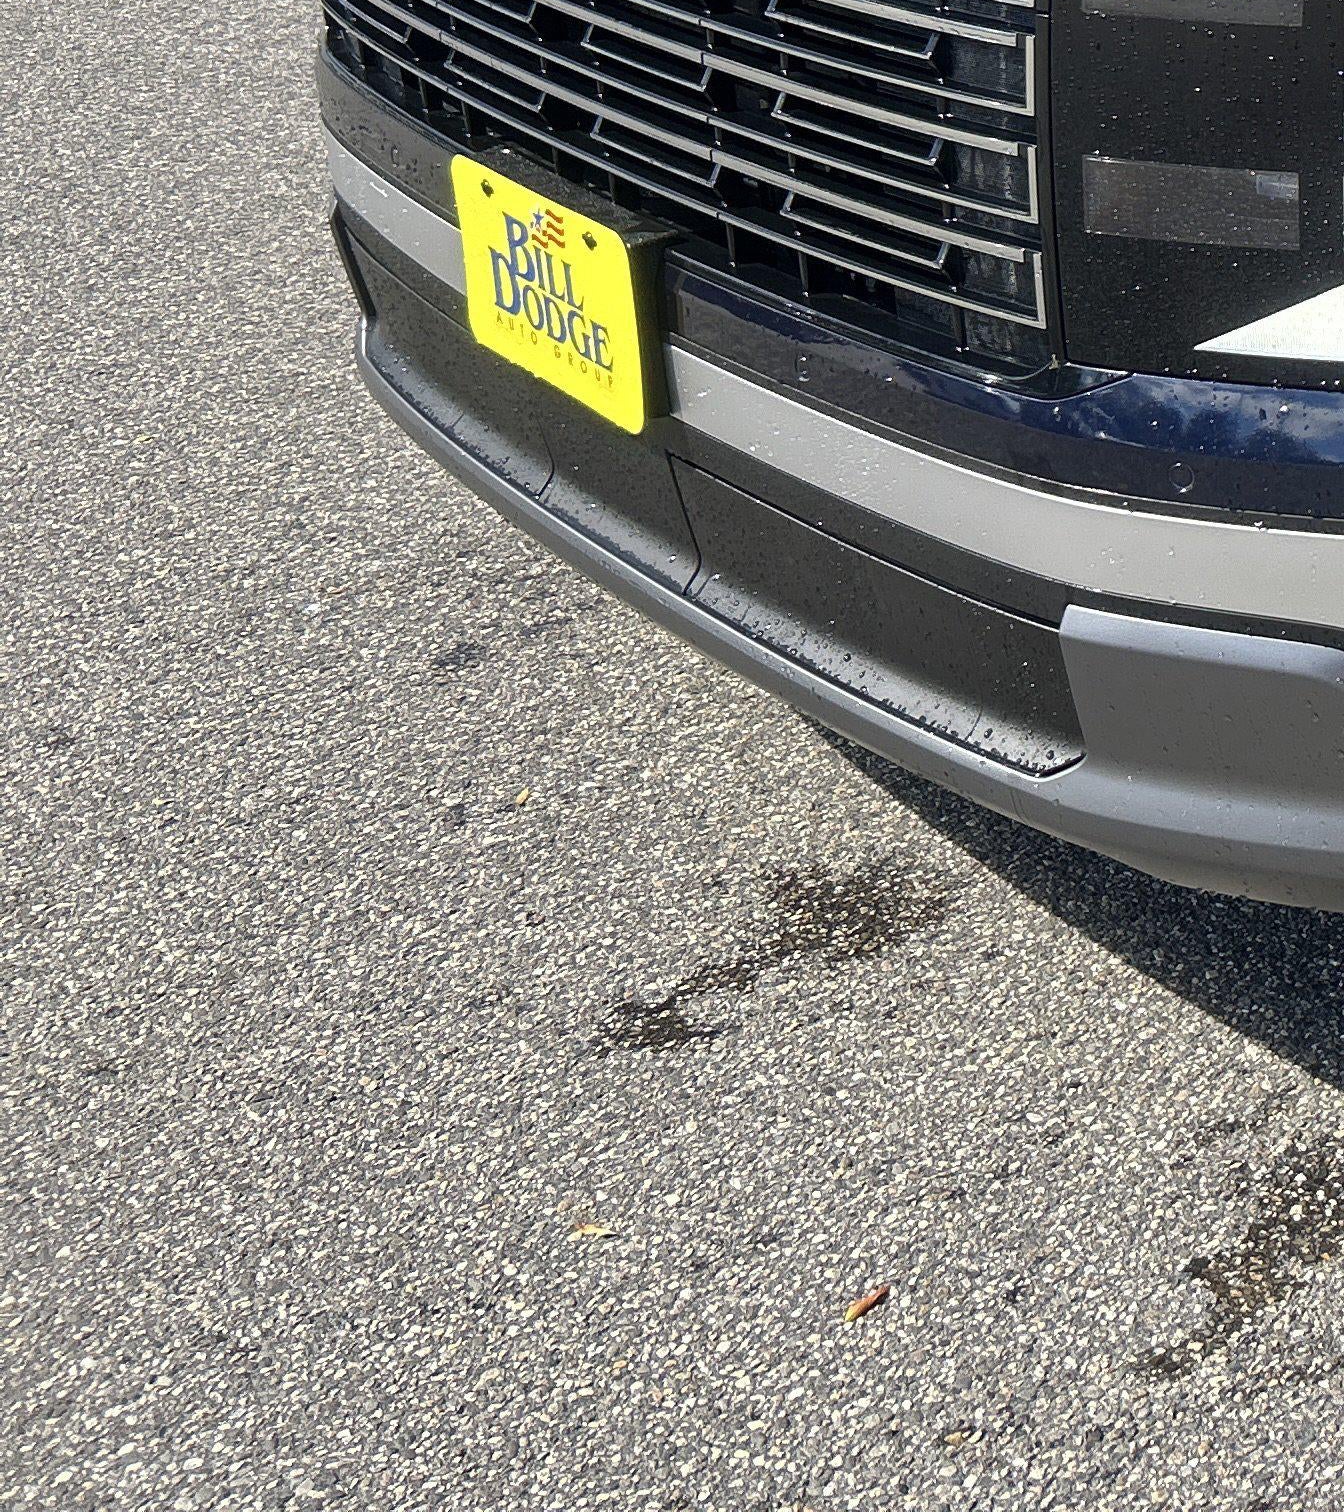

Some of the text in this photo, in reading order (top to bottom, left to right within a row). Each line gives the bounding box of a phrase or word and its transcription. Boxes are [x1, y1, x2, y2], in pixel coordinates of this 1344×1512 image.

[488, 245, 614, 373] DODGE
[502, 211, 585, 312] BILL
[496, 310, 614, 387] AUTO GROUP
